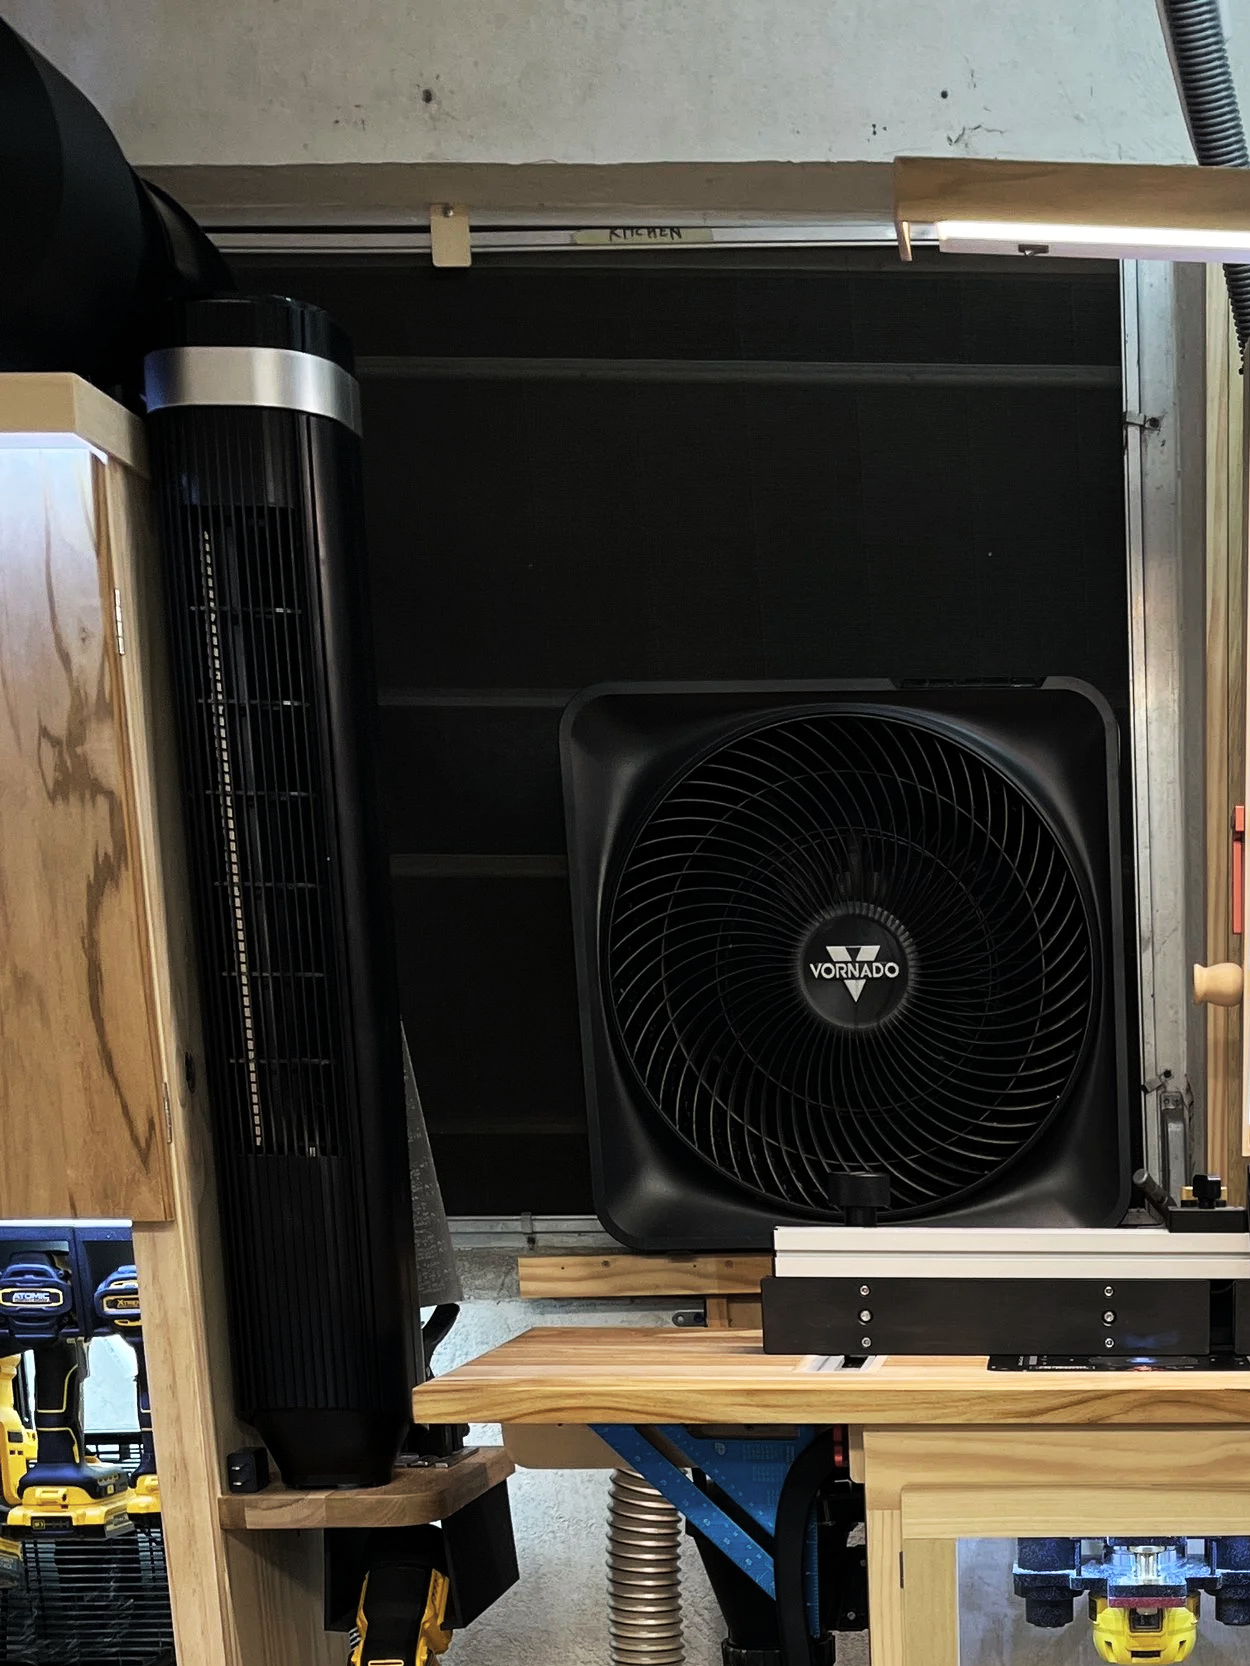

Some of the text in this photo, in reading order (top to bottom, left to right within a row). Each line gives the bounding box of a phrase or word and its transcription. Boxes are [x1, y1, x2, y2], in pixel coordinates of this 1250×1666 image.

[608, 226, 682, 241] KITCHEN
[809, 961, 900, 979] VORNADO
[12, 1292, 50, 1300] ATOMIC
